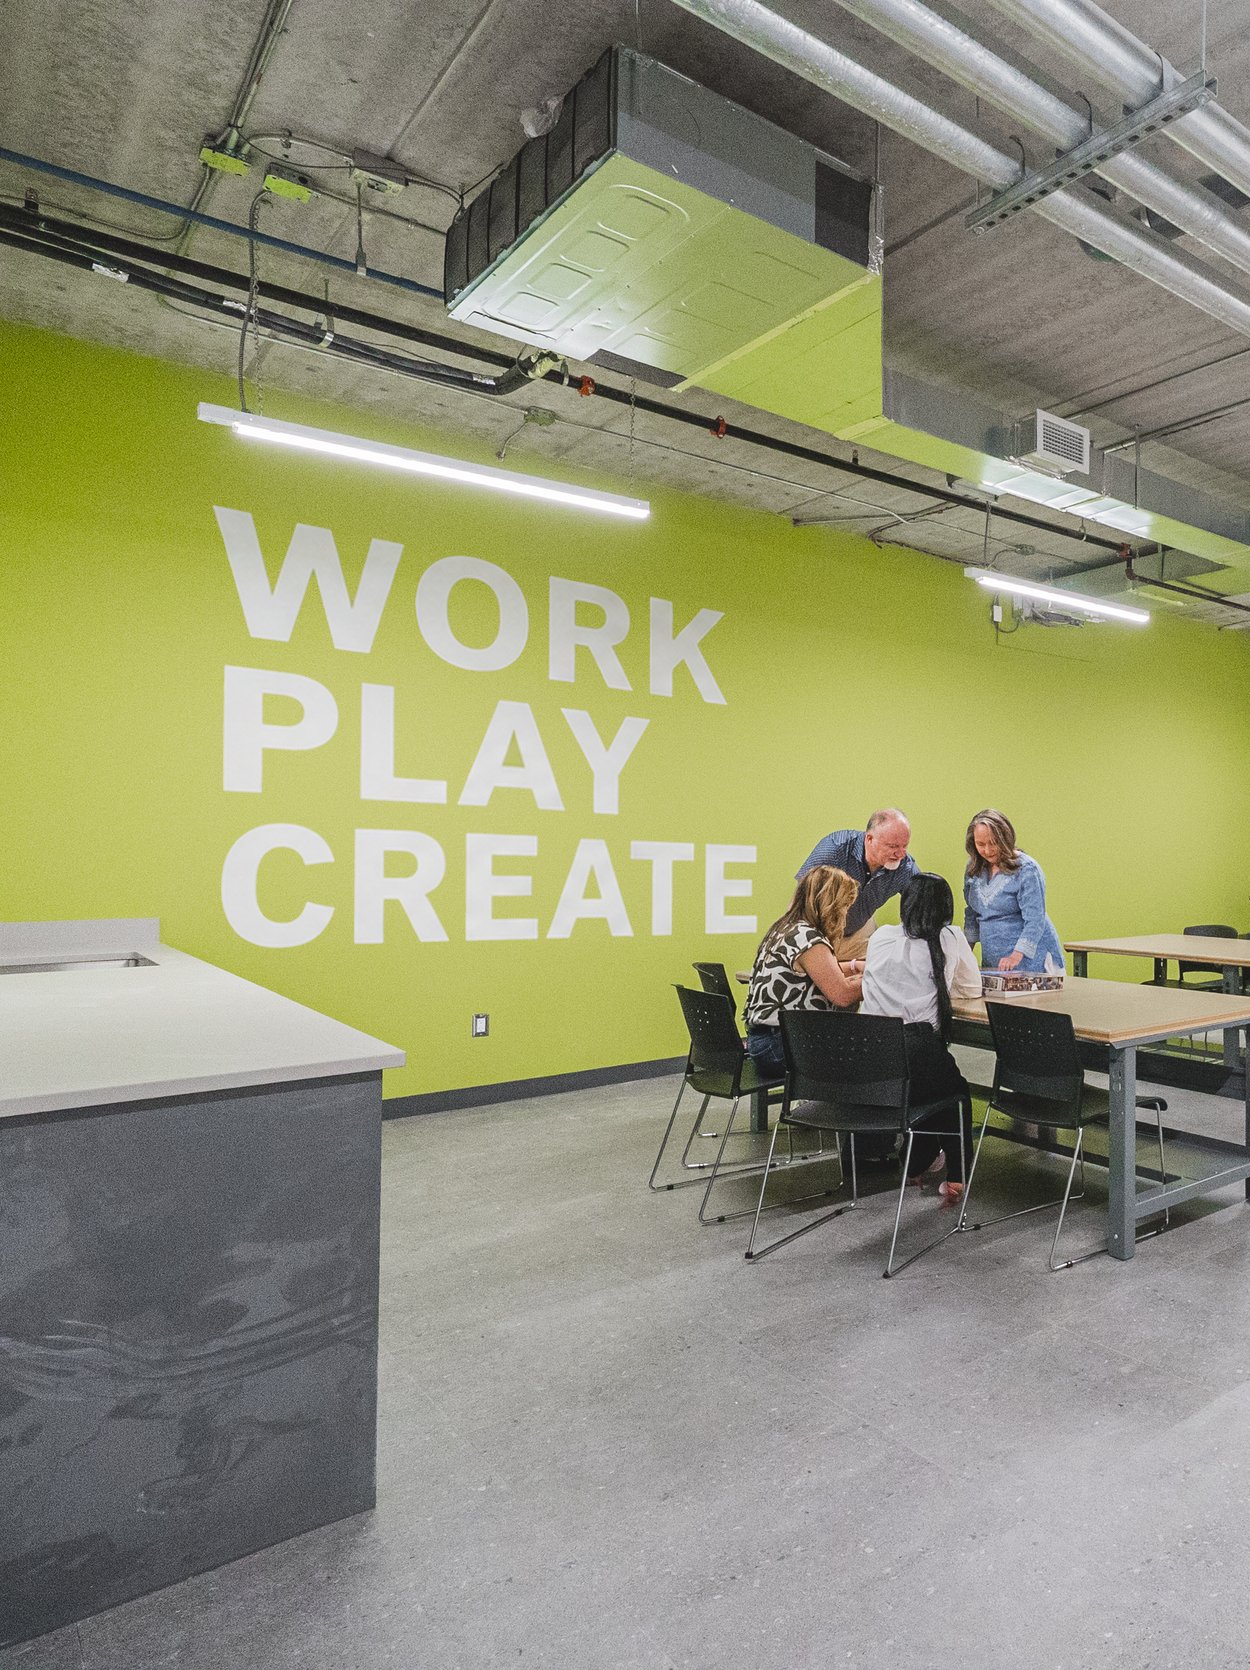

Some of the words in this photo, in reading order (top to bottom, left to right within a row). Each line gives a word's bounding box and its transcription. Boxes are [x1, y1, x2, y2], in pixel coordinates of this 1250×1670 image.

[213, 504, 728, 706] WORK
[222, 664, 651, 815] PLAY
[220, 822, 759, 949] CREATE
